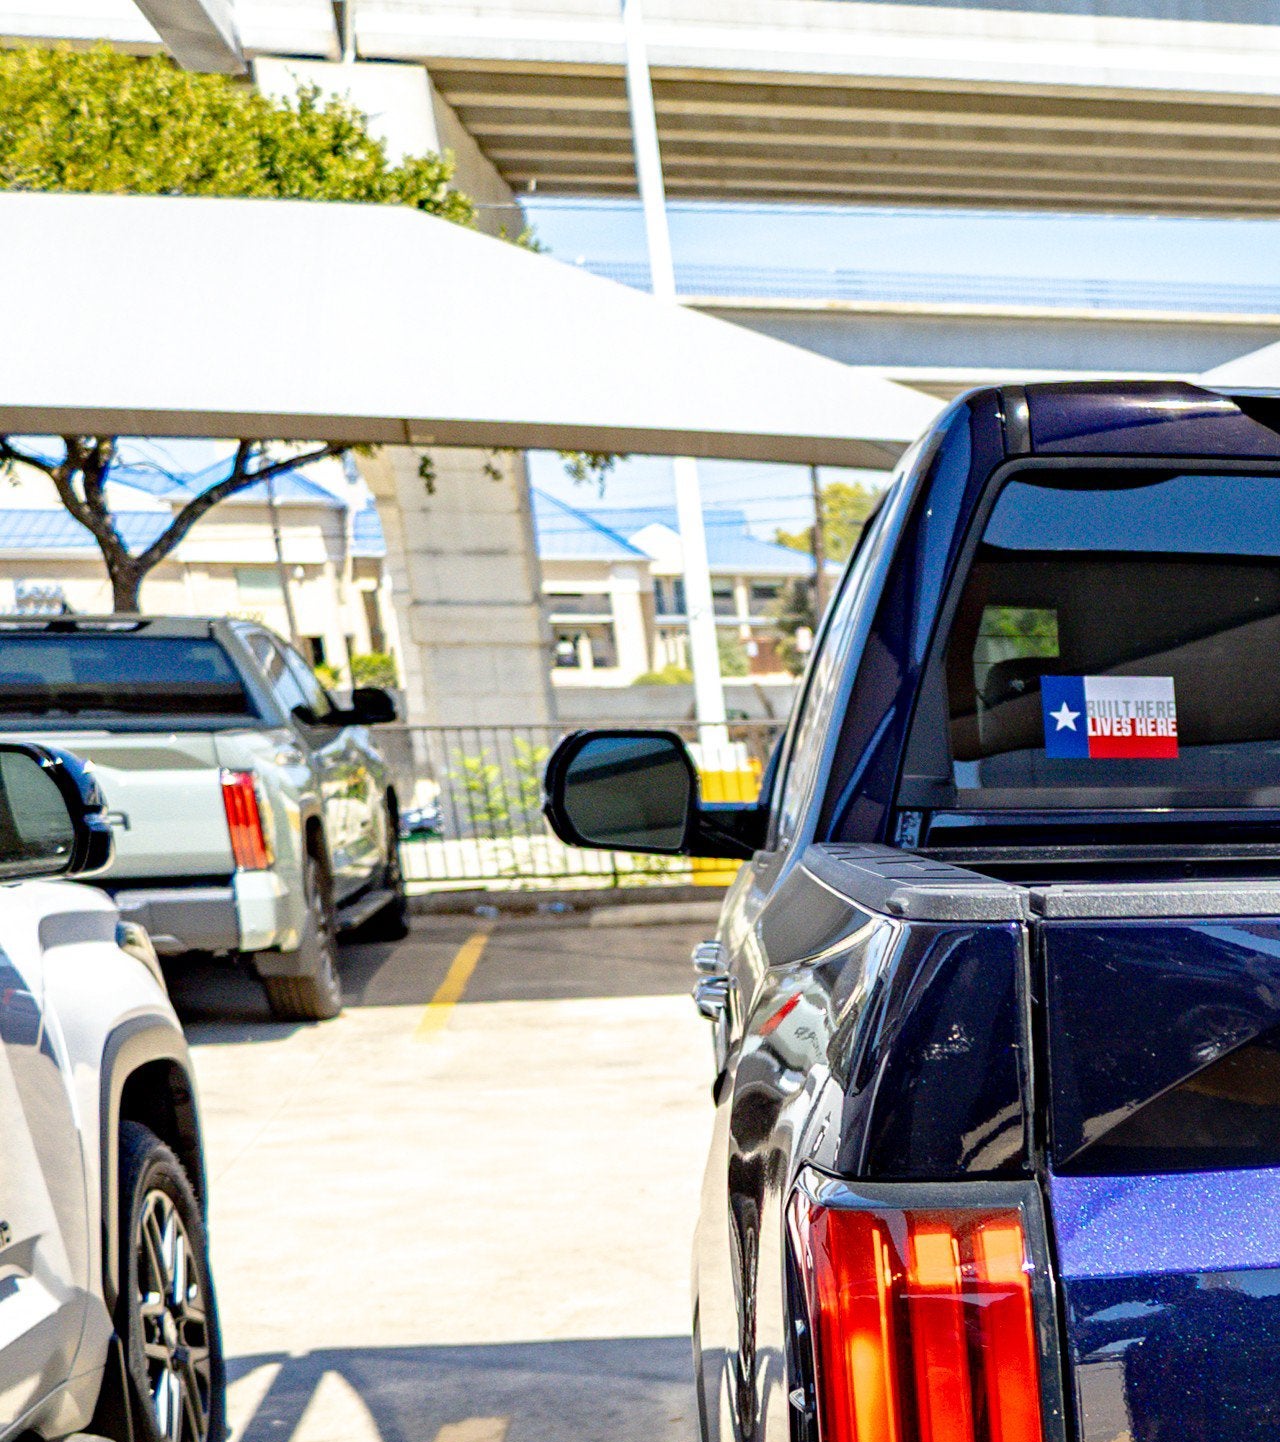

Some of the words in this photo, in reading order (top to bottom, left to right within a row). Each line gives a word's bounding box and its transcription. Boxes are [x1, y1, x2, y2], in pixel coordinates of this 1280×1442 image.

[1087, 700, 1131, 718] BUILT
[1135, 700, 1176, 718] HERE
[1088, 718, 1132, 737] LIVES
[1135, 718, 1178, 737] HERE
